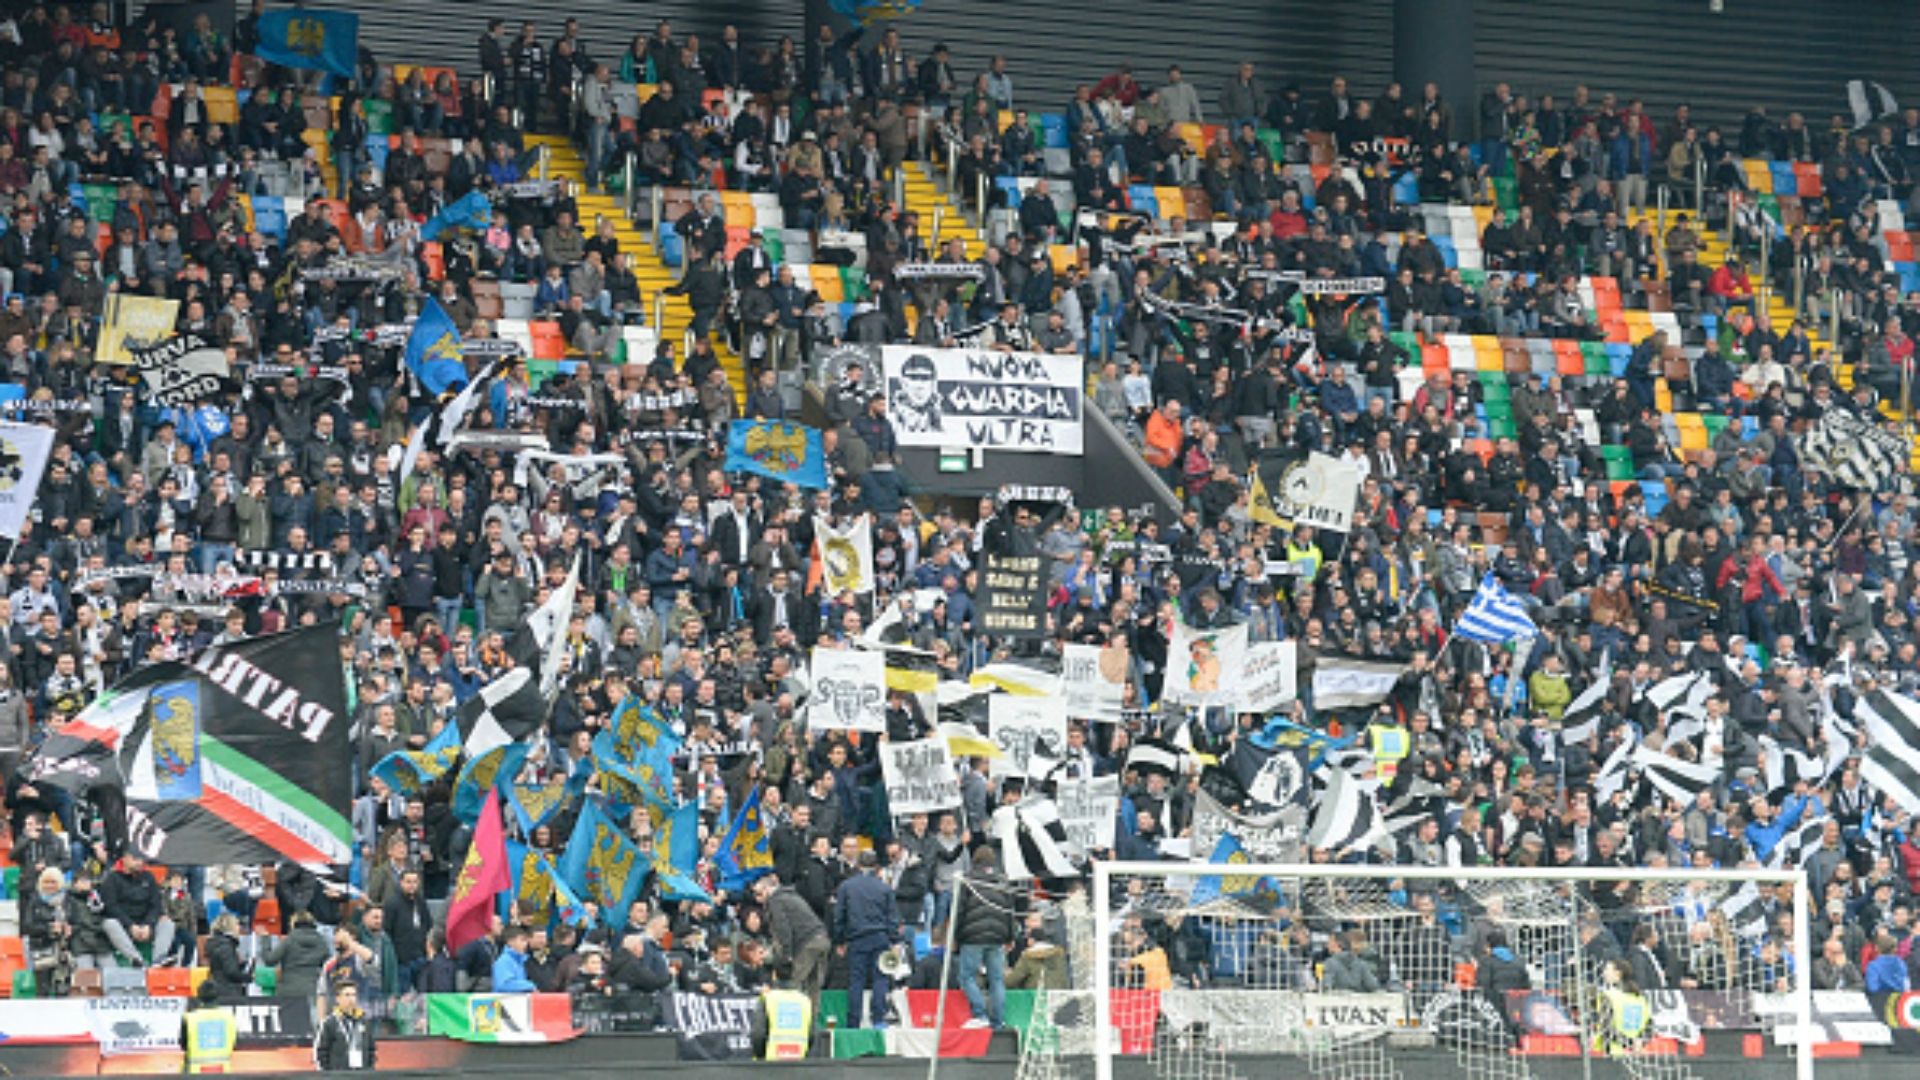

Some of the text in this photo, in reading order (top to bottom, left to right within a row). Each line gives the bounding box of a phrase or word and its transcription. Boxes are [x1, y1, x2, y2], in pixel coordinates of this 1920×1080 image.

[967, 355, 1050, 380] NUOVA
[950, 384, 1071, 416] GUARDIA
[966, 419, 1054, 447] ULTRA
[1319, 1005, 1388, 1026] IVAN
